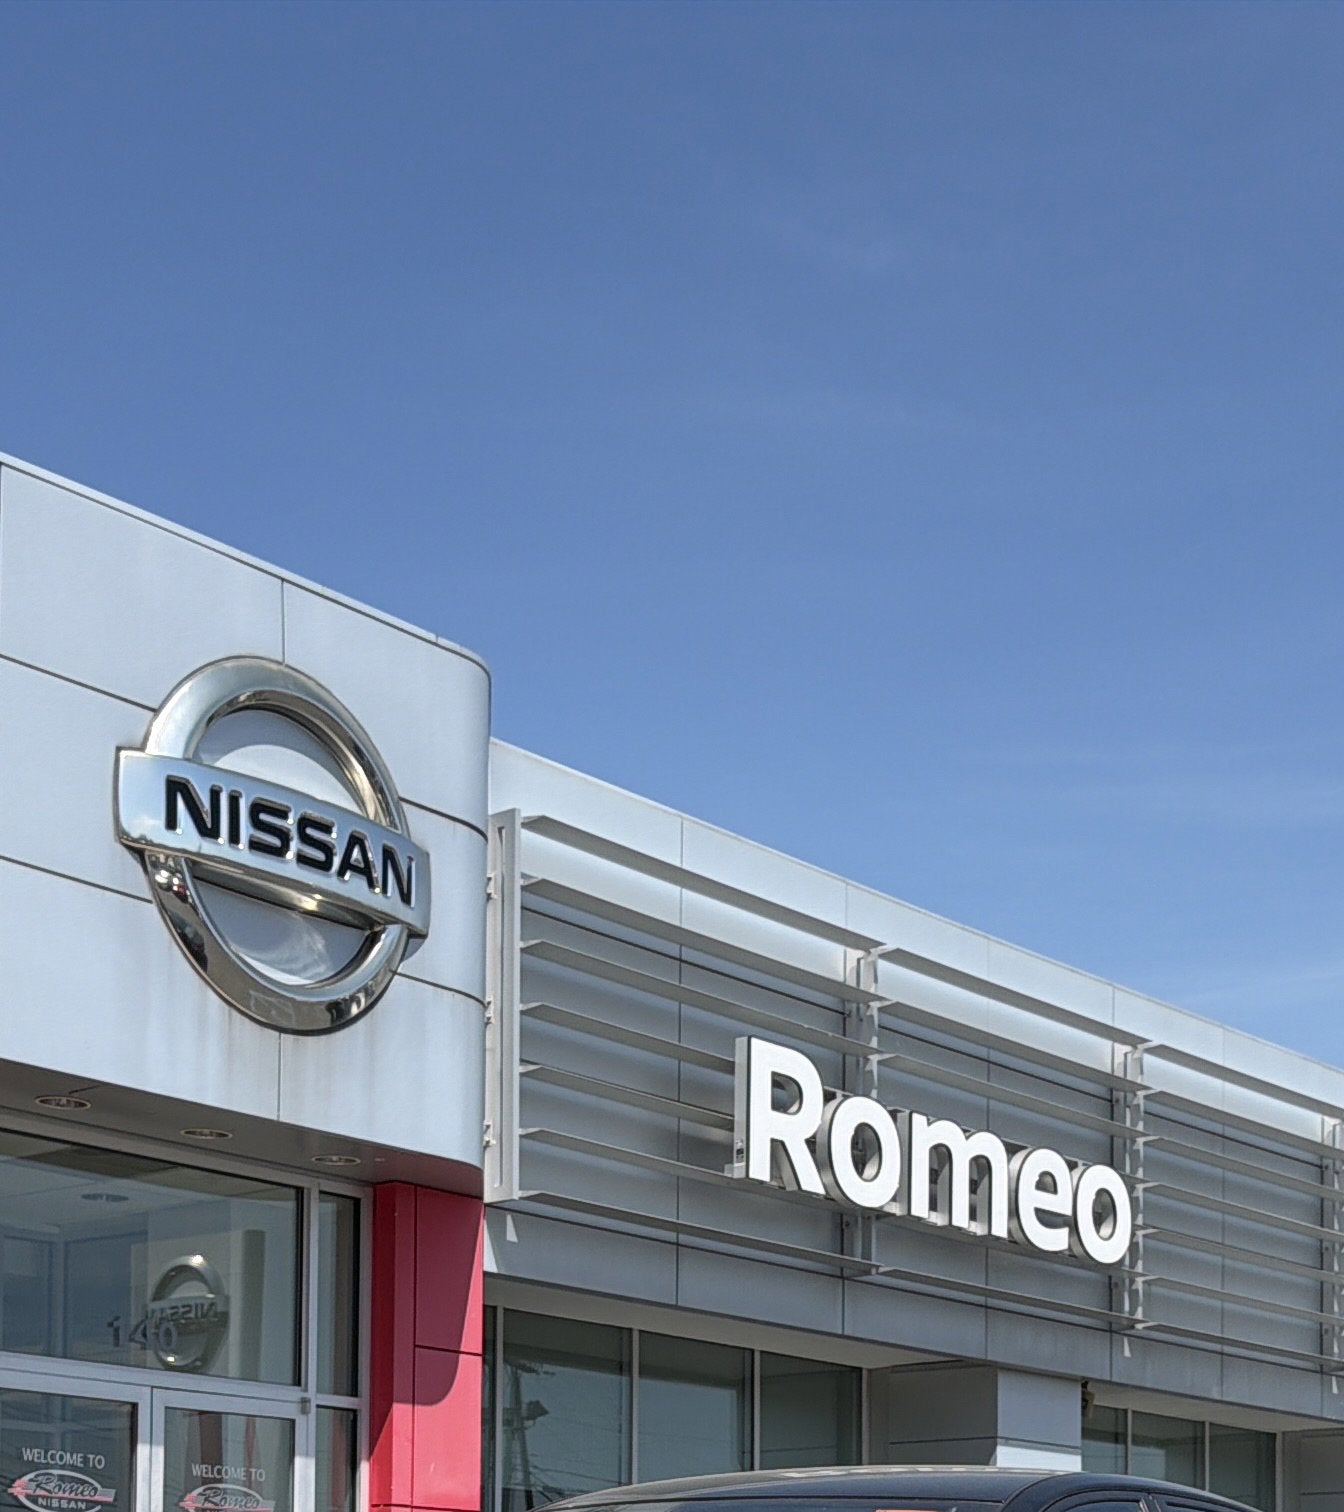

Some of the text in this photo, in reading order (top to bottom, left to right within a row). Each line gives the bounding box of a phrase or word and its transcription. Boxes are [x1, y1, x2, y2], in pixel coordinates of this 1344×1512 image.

[164, 774, 416, 908] NISSAN
[738, 1036, 1132, 1265] Romeo
[22, 1447, 105, 1469] WELCOME TO
[191, 1462, 266, 1482] WELCOME TO
[32, 1472, 99, 1497] Romeo
[37, 1497, 86, 1510] NISSAN
